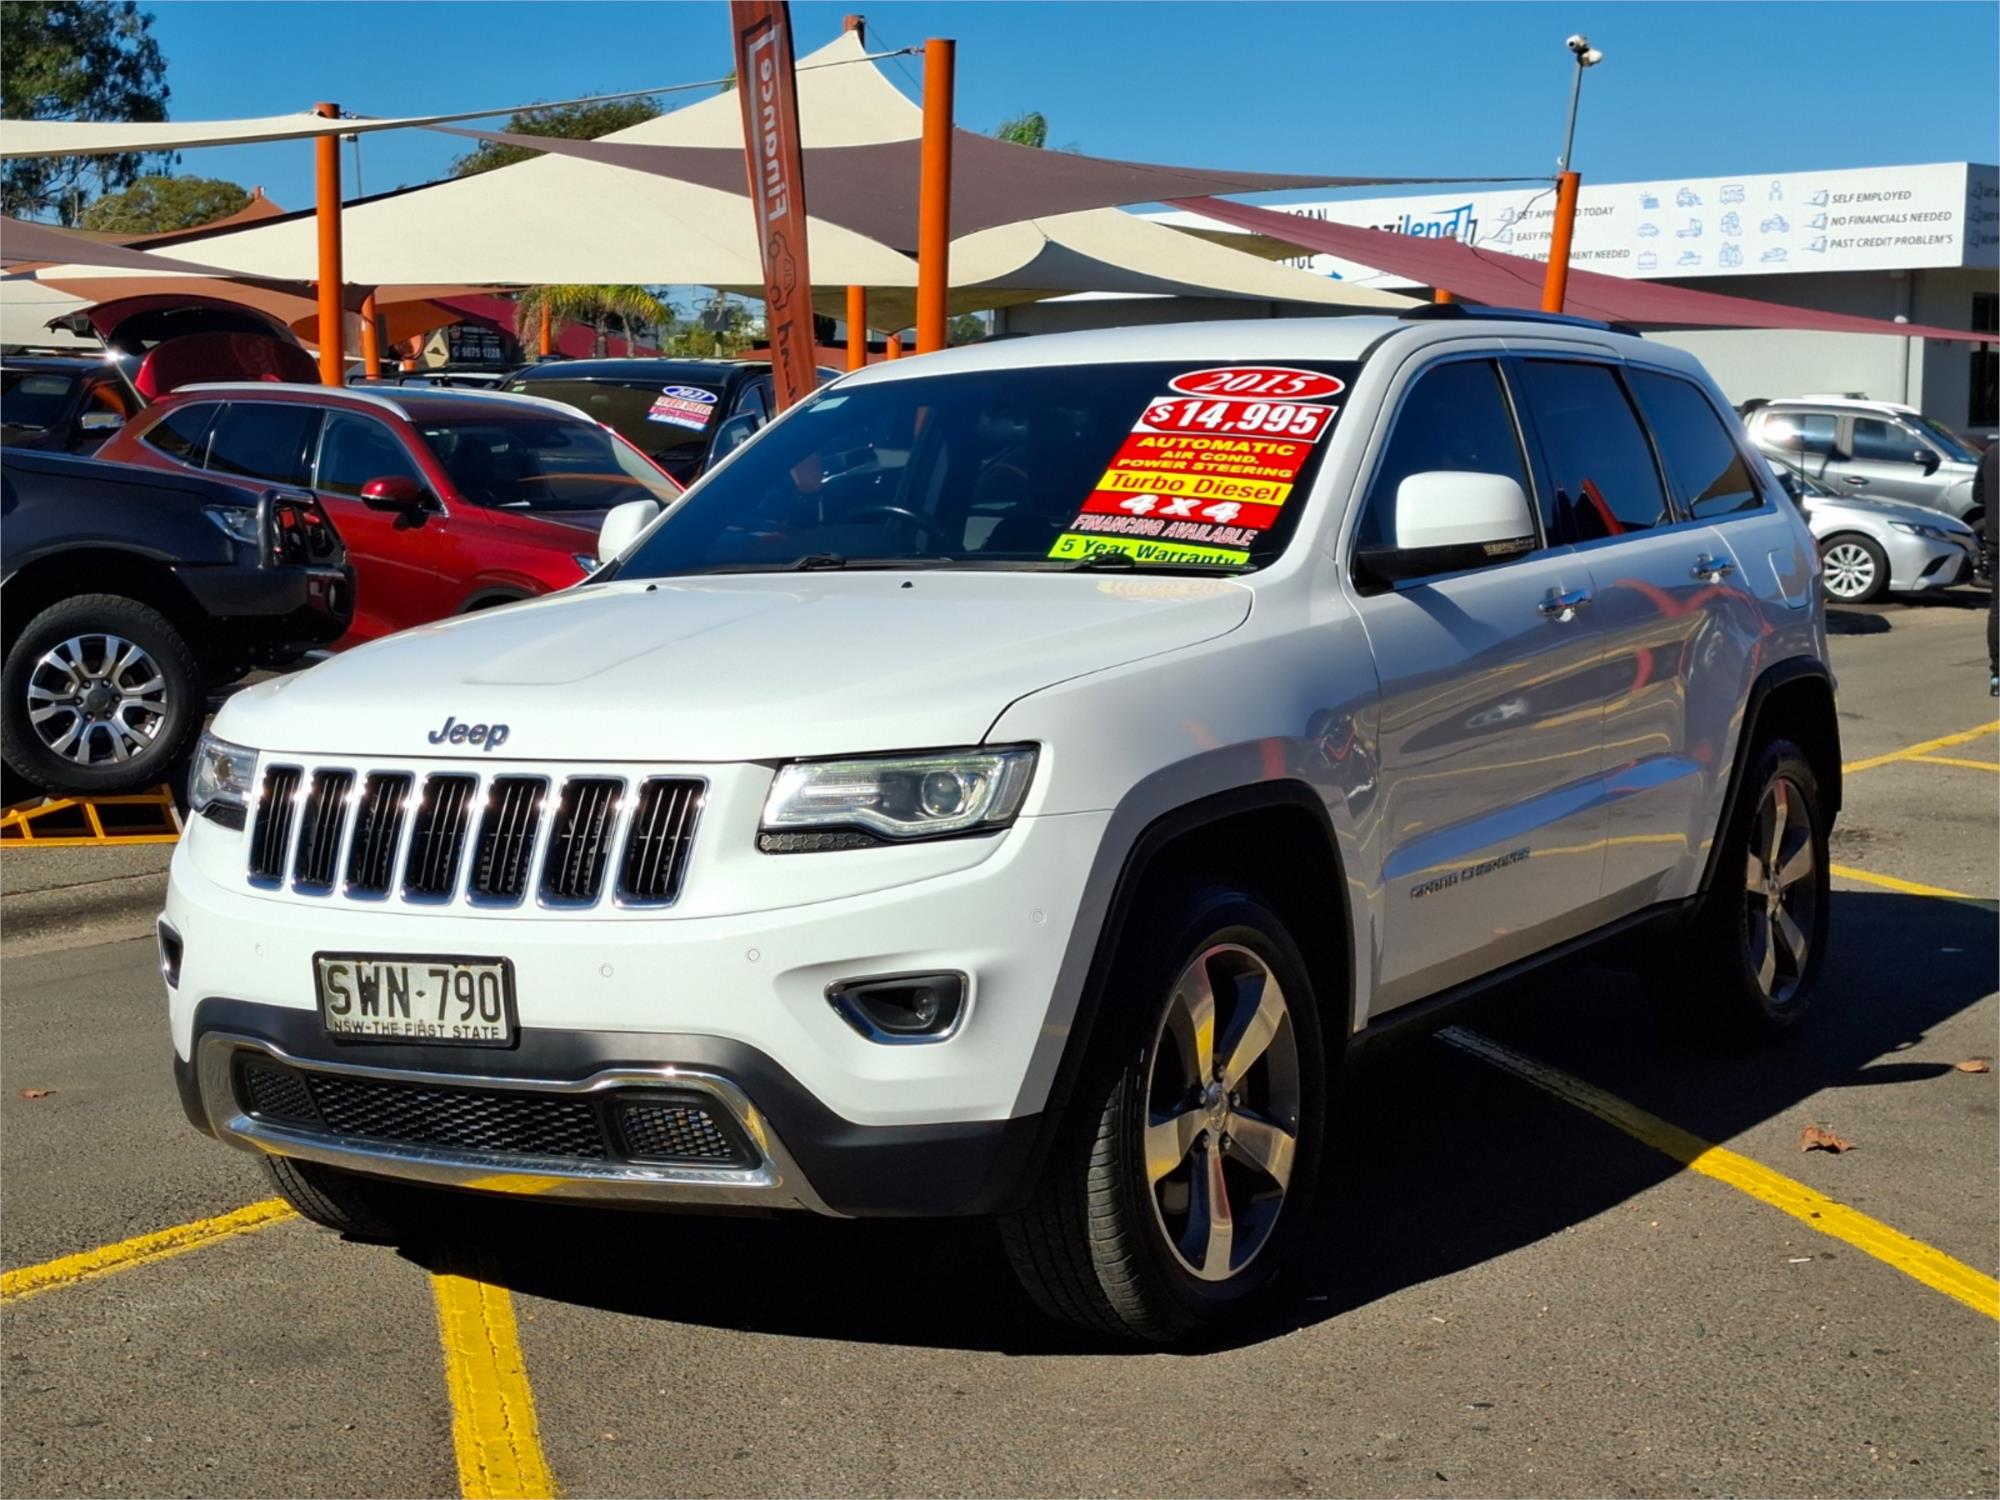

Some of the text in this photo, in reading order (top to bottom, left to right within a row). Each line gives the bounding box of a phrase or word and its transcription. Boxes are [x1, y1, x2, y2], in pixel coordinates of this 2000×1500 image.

[761, 57, 788, 221] Finance
[1832, 191, 1912, 204] SELF EMPLOYED
[1584, 206, 1615, 217] TODAY
[1830, 211, 1953, 226] NO FINANCIALS NEEDED
[1516, 231, 1537, 241] EASY
[1830, 234, 1954, 249] PAST CREDIT PROBLEM'S
[1595, 248, 1631, 259] NEEDED
[1191, 372, 1321, 395] 2015
[1150, 400, 1325, 435] $14,995
[1136, 437, 1297, 456] AUTOMATIC
[1160, 450, 1260, 465] AIR COND.
[1117, 459, 1294, 478] POWER STEERING
[1110, 473, 1282, 501] Turbo Diesel
[1069, 514, 1258, 547] FINANCING AVAILABLE
[1060, 538, 1237, 565] 5 Year Warranty
[427, 716, 510, 752] Jeep
[405, 1022, 446, 1038] FIRST
[452, 1024, 500, 1040] STATE
